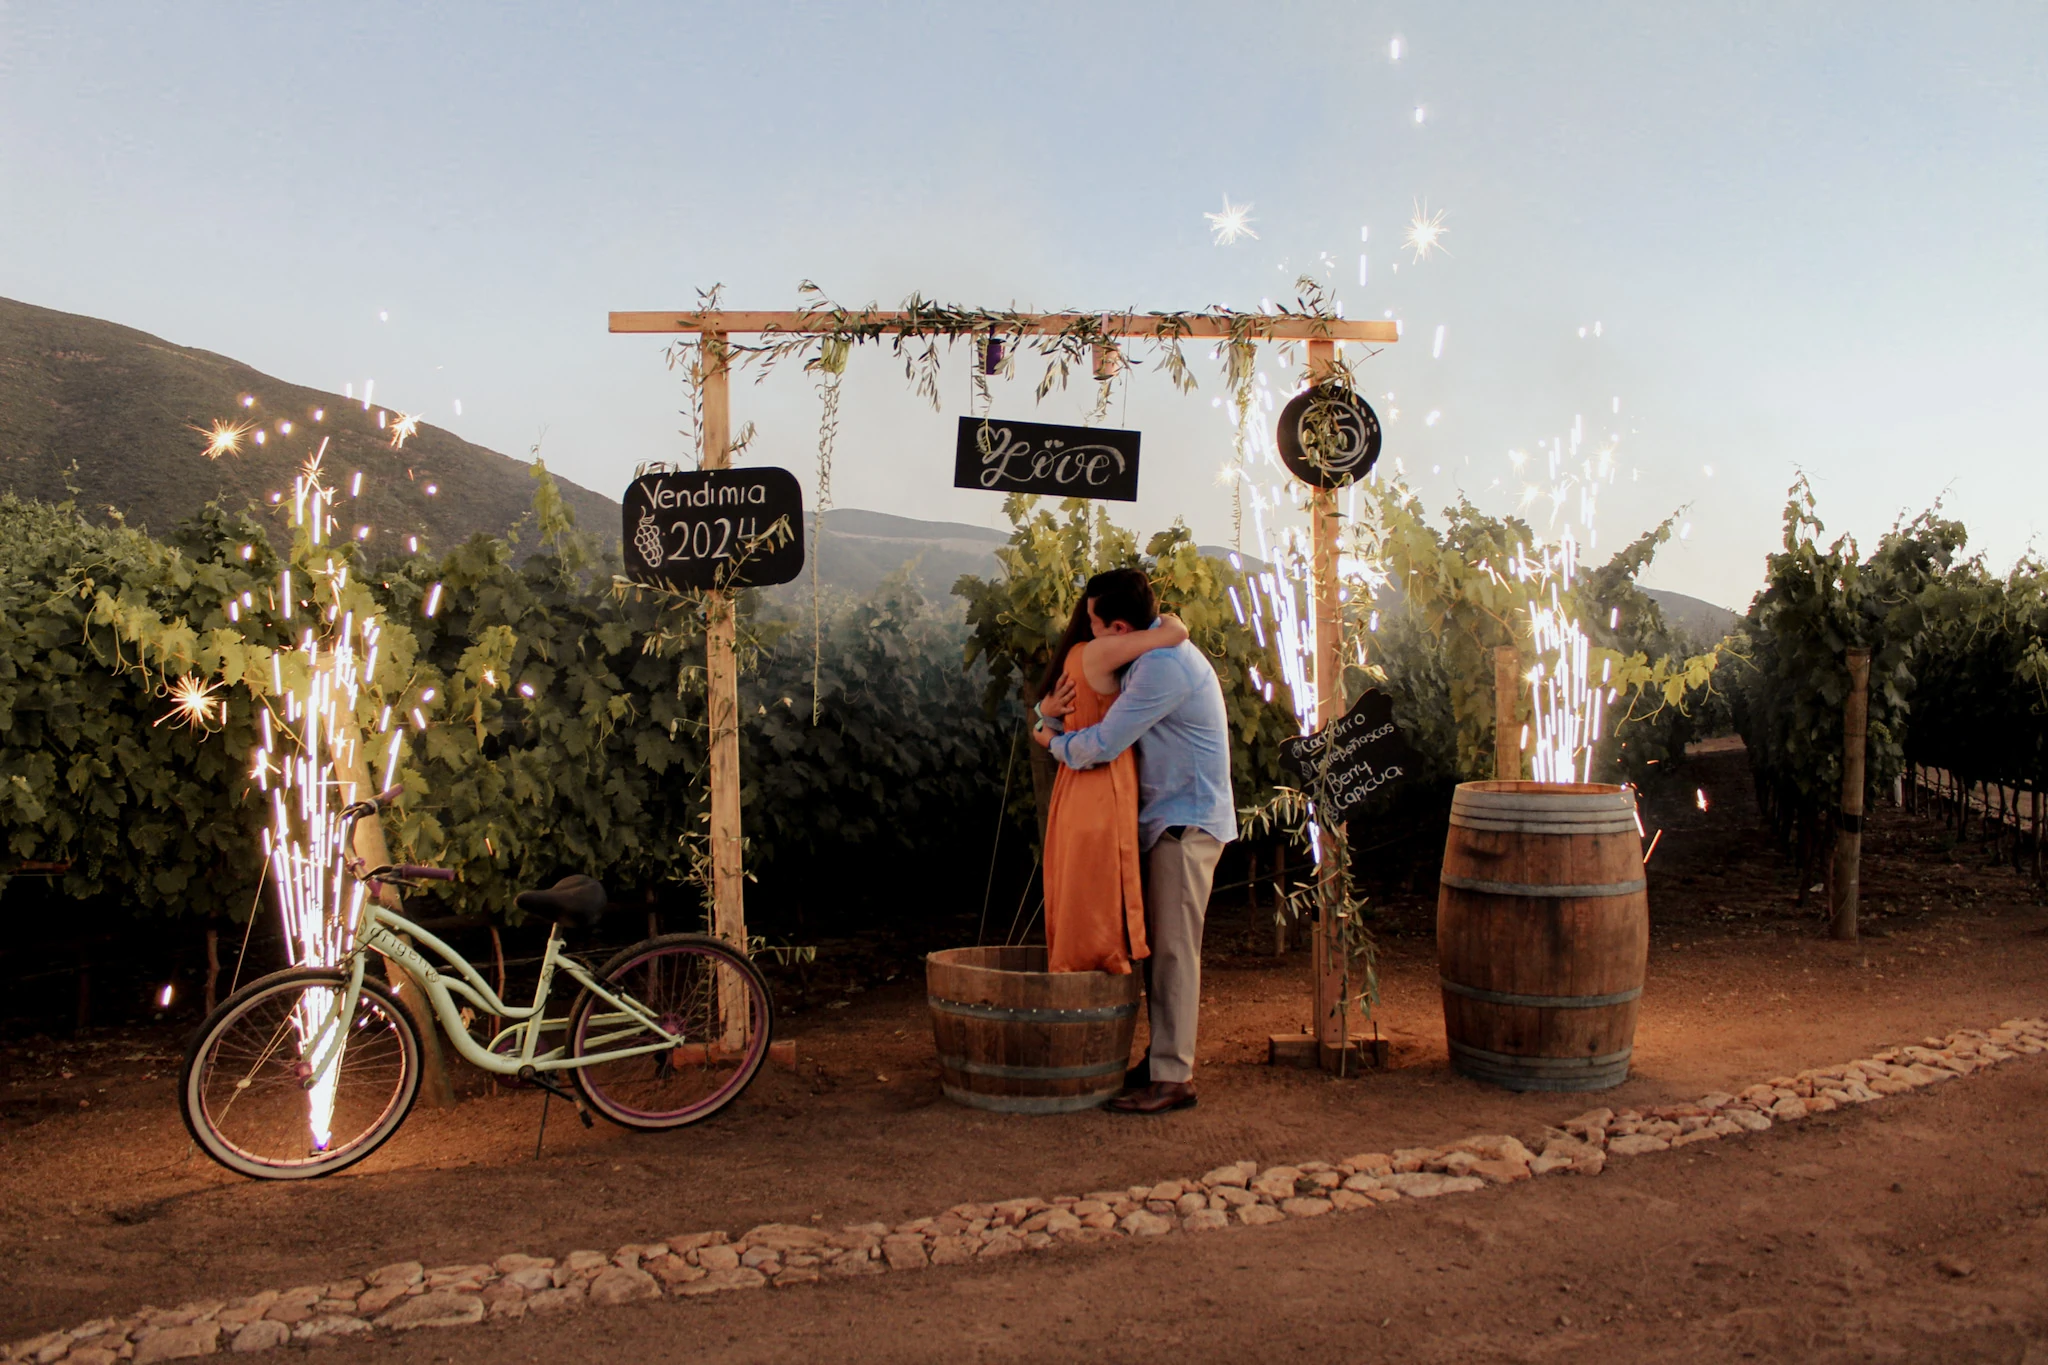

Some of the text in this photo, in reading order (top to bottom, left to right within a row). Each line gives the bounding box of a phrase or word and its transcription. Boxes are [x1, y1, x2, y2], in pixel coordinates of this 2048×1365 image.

[977, 426, 1126, 487] Love
[640, 479, 766, 509] Vendimia
[667, 516, 757, 561] 2024
[1326, 761, 1373, 795] Berry
